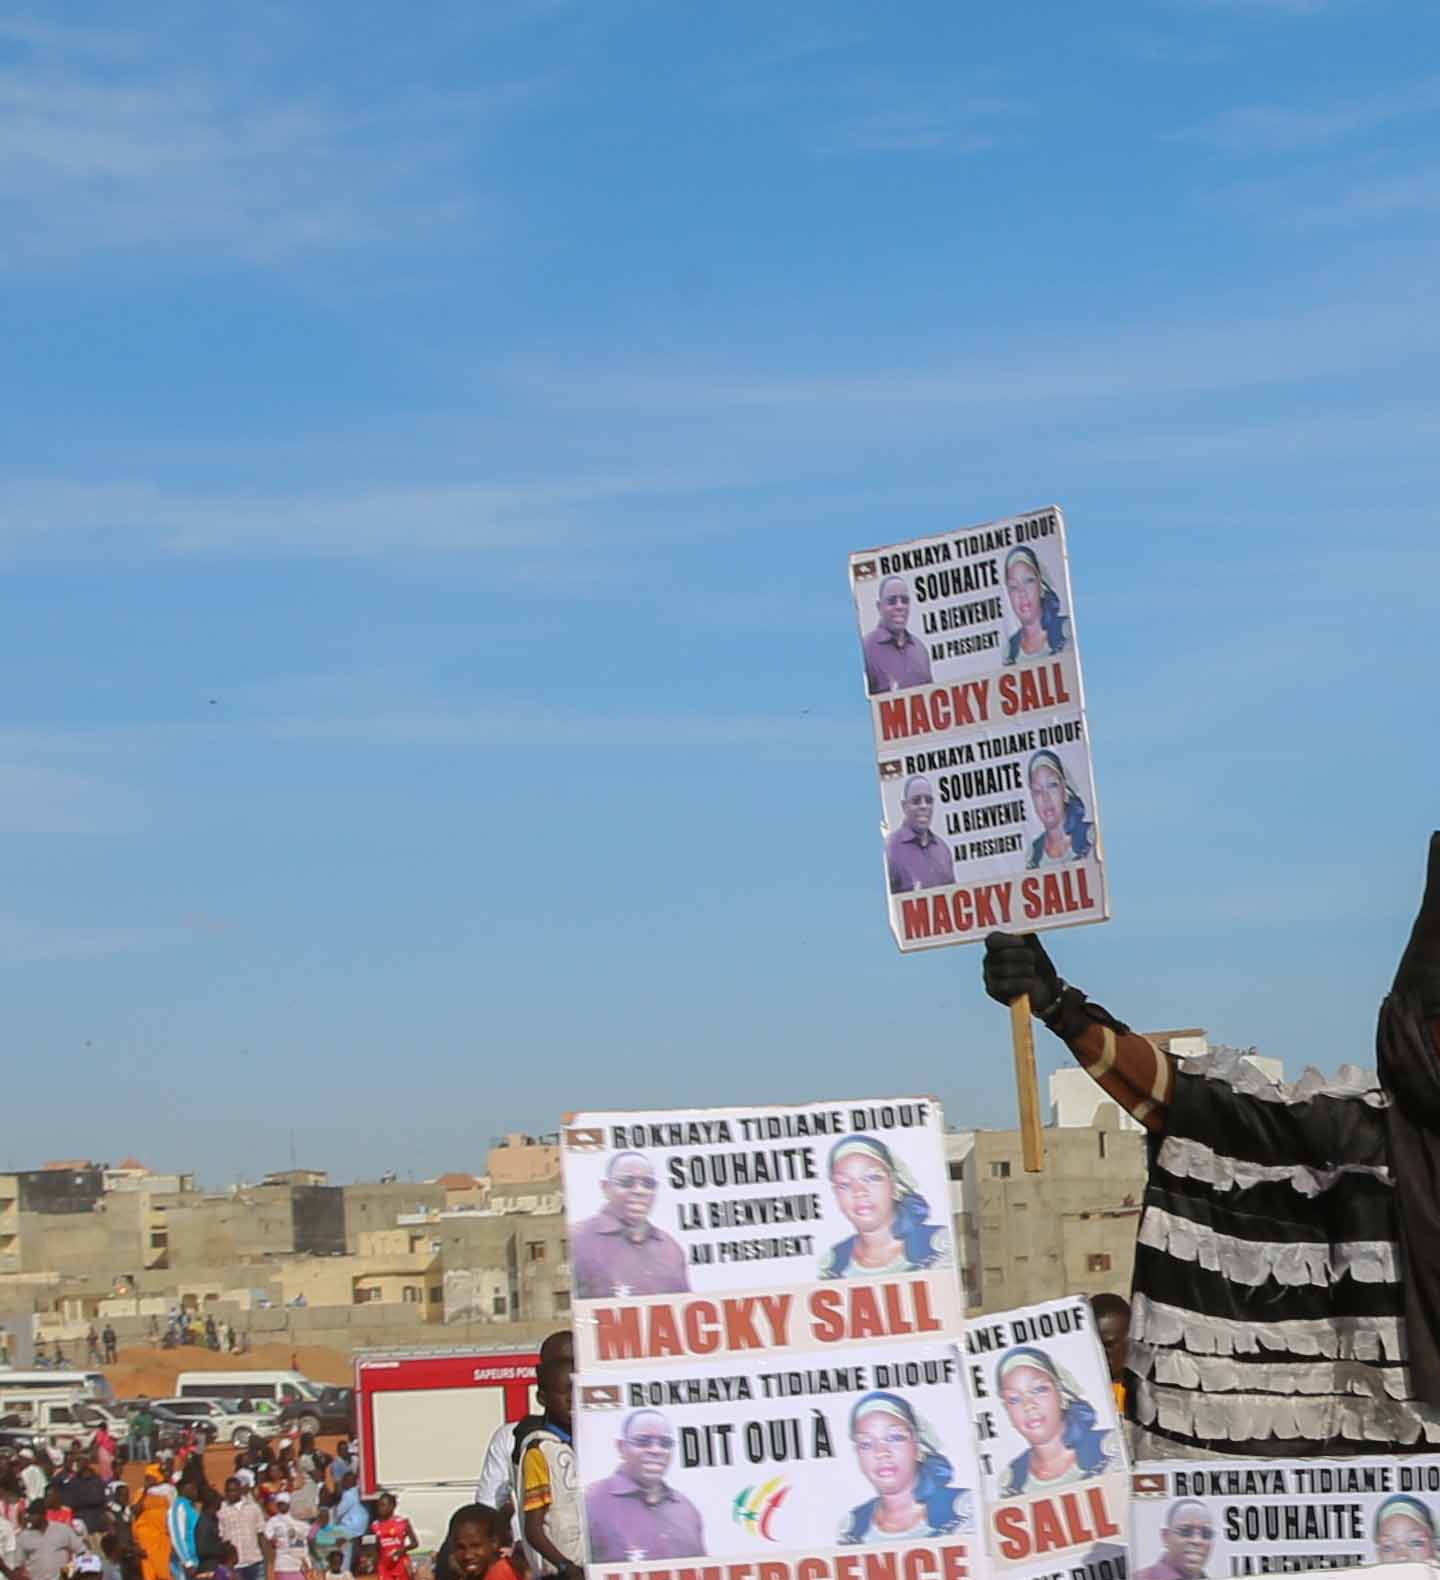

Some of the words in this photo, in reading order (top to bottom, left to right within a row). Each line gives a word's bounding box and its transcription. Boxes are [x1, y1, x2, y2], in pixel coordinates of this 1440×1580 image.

[880, 542, 951, 575] ROKHAYA
[955, 527, 1012, 557] TIDIANE
[1016, 515, 1056, 544] DIOUF
[915, 560, 999, 602] SOUHAITE
[922, 611, 938, 634] LA
[941, 597, 1003, 631] BIENVENUE
[932, 642, 944, 660] AU
[947, 632, 1000, 657] PRESIDENT
[879, 681, 991, 741] MACKY
[1000, 664, 1069, 716] SALL
[906, 745, 976, 775] ROKHAYA
[978, 730, 1036, 761] TIDIANE
[1039, 720, 1081, 746] DIOUF
[939, 762, 1023, 803] SOUHAITE
[946, 812, 961, 835] LA
[963, 800, 1026, 832] BIENVENUE
[969, 834, 1023, 858] PRESIDENT
[903, 882, 1013, 940] MACKY
[1022, 868, 1094, 919] SALL
[612, 1121, 735, 1149] ROKHAYA
[739, 1112, 843, 1141] TIDIANE
[850, 1104, 931, 1131] DIOUF
[667, 1148, 817, 1190] SOUHAITE
[676, 1203, 702, 1231] LA
[593, 1293, 792, 1361] MACKY
[809, 1280, 943, 1343] SALL
[1012, 1307, 1085, 1344] DIOUF
[474, 1368, 515, 1380] SAPEURS
[629, 1376, 752, 1406] ROKHAYA
[759, 1366, 867, 1396] TIDIANE
[873, 1358, 956, 1387] DIOUF
[680, 1423, 734, 1468] DIT
[745, 1415, 804, 1462] OUI
[812, 1409, 836, 1459] À
[1175, 1470, 1287, 1496] ROKHAYA
[1295, 1467, 1391, 1493] TIDIANE
[993, 1486, 1119, 1560] SALL
[1225, 1504, 1365, 1541] SOUHAITE
